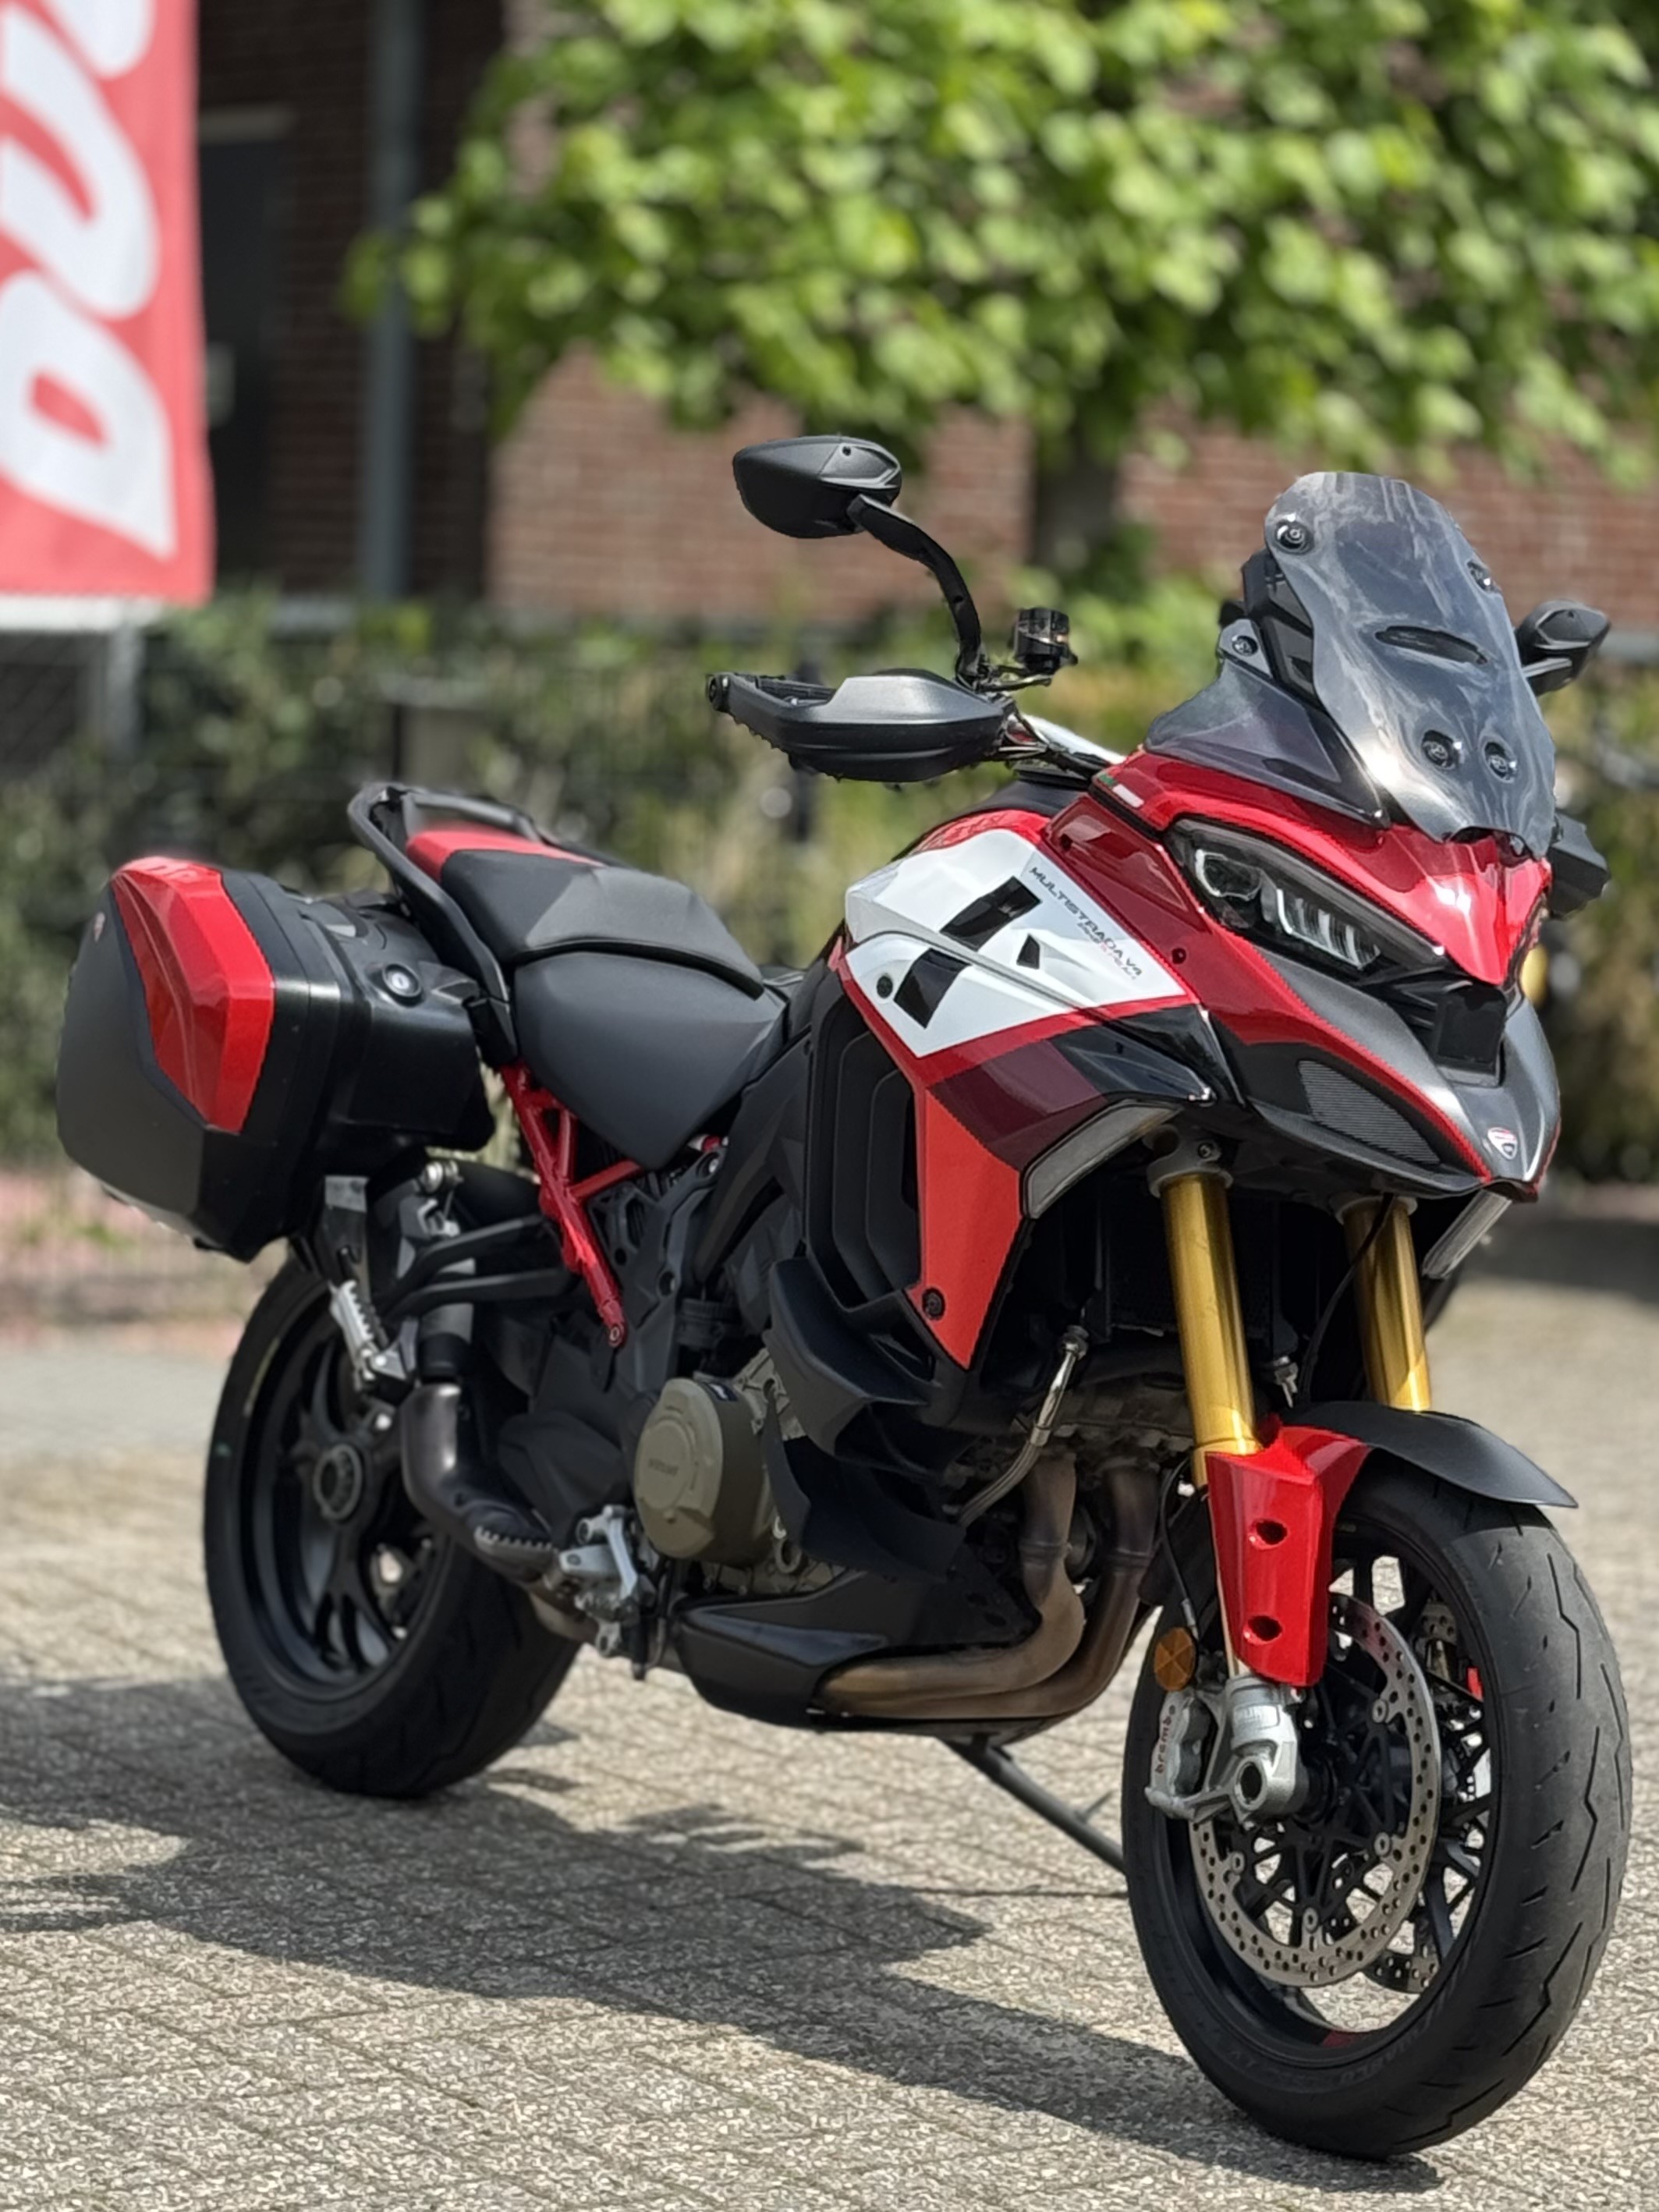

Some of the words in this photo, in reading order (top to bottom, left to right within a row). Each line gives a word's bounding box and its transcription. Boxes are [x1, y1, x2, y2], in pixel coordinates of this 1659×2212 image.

[1029, 867, 1124, 959] MULTISTRADA
[1125, 957, 1143, 977] V4
[1154, 1704, 1176, 1774] brembo
